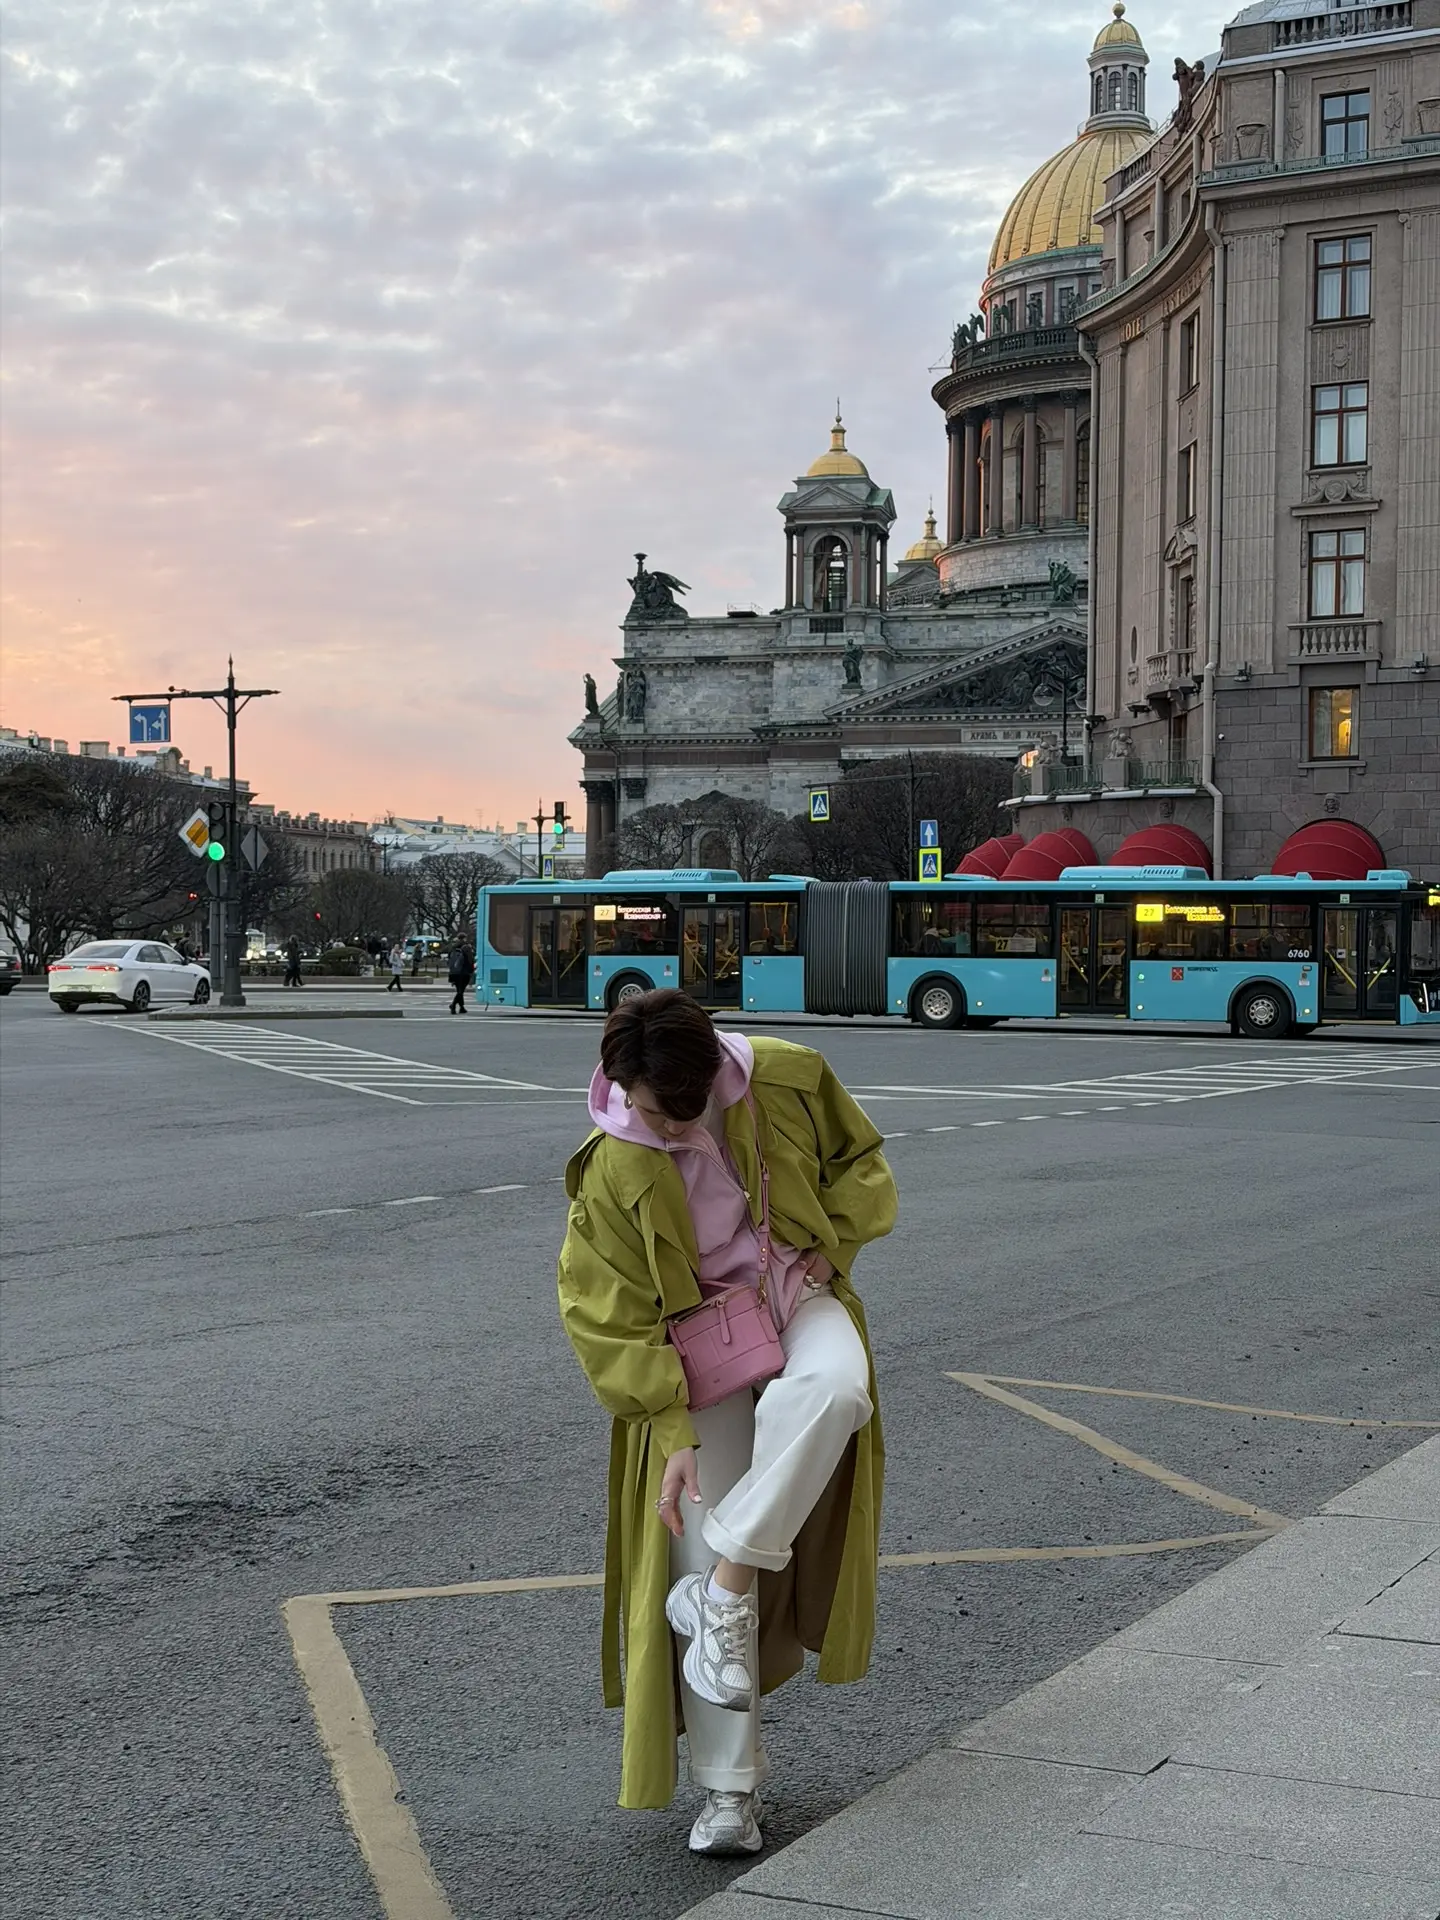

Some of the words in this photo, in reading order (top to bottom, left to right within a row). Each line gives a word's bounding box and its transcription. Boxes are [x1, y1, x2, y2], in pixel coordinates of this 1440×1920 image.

[1143, 908, 1155, 917] 27
[997, 939, 1009, 950] 27
[1287, 949, 1310, 958] 6760
